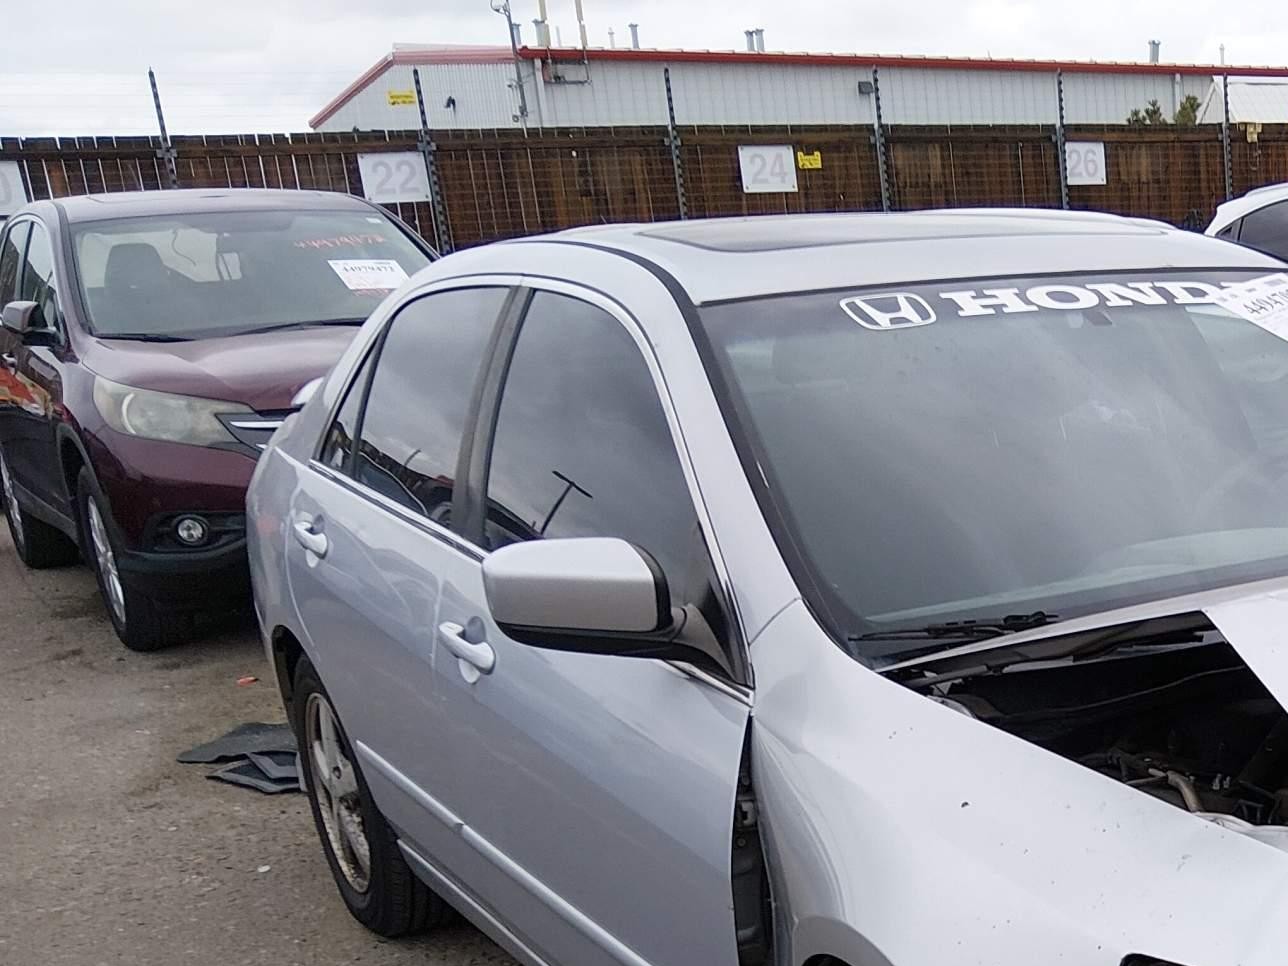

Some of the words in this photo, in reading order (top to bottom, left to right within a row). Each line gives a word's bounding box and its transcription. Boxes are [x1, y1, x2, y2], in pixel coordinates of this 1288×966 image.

[372, 160, 420, 195] 22
[750, 153, 787, 184] 24
[1068, 149, 1098, 178] 26
[939, 282, 1240, 314] HOND
